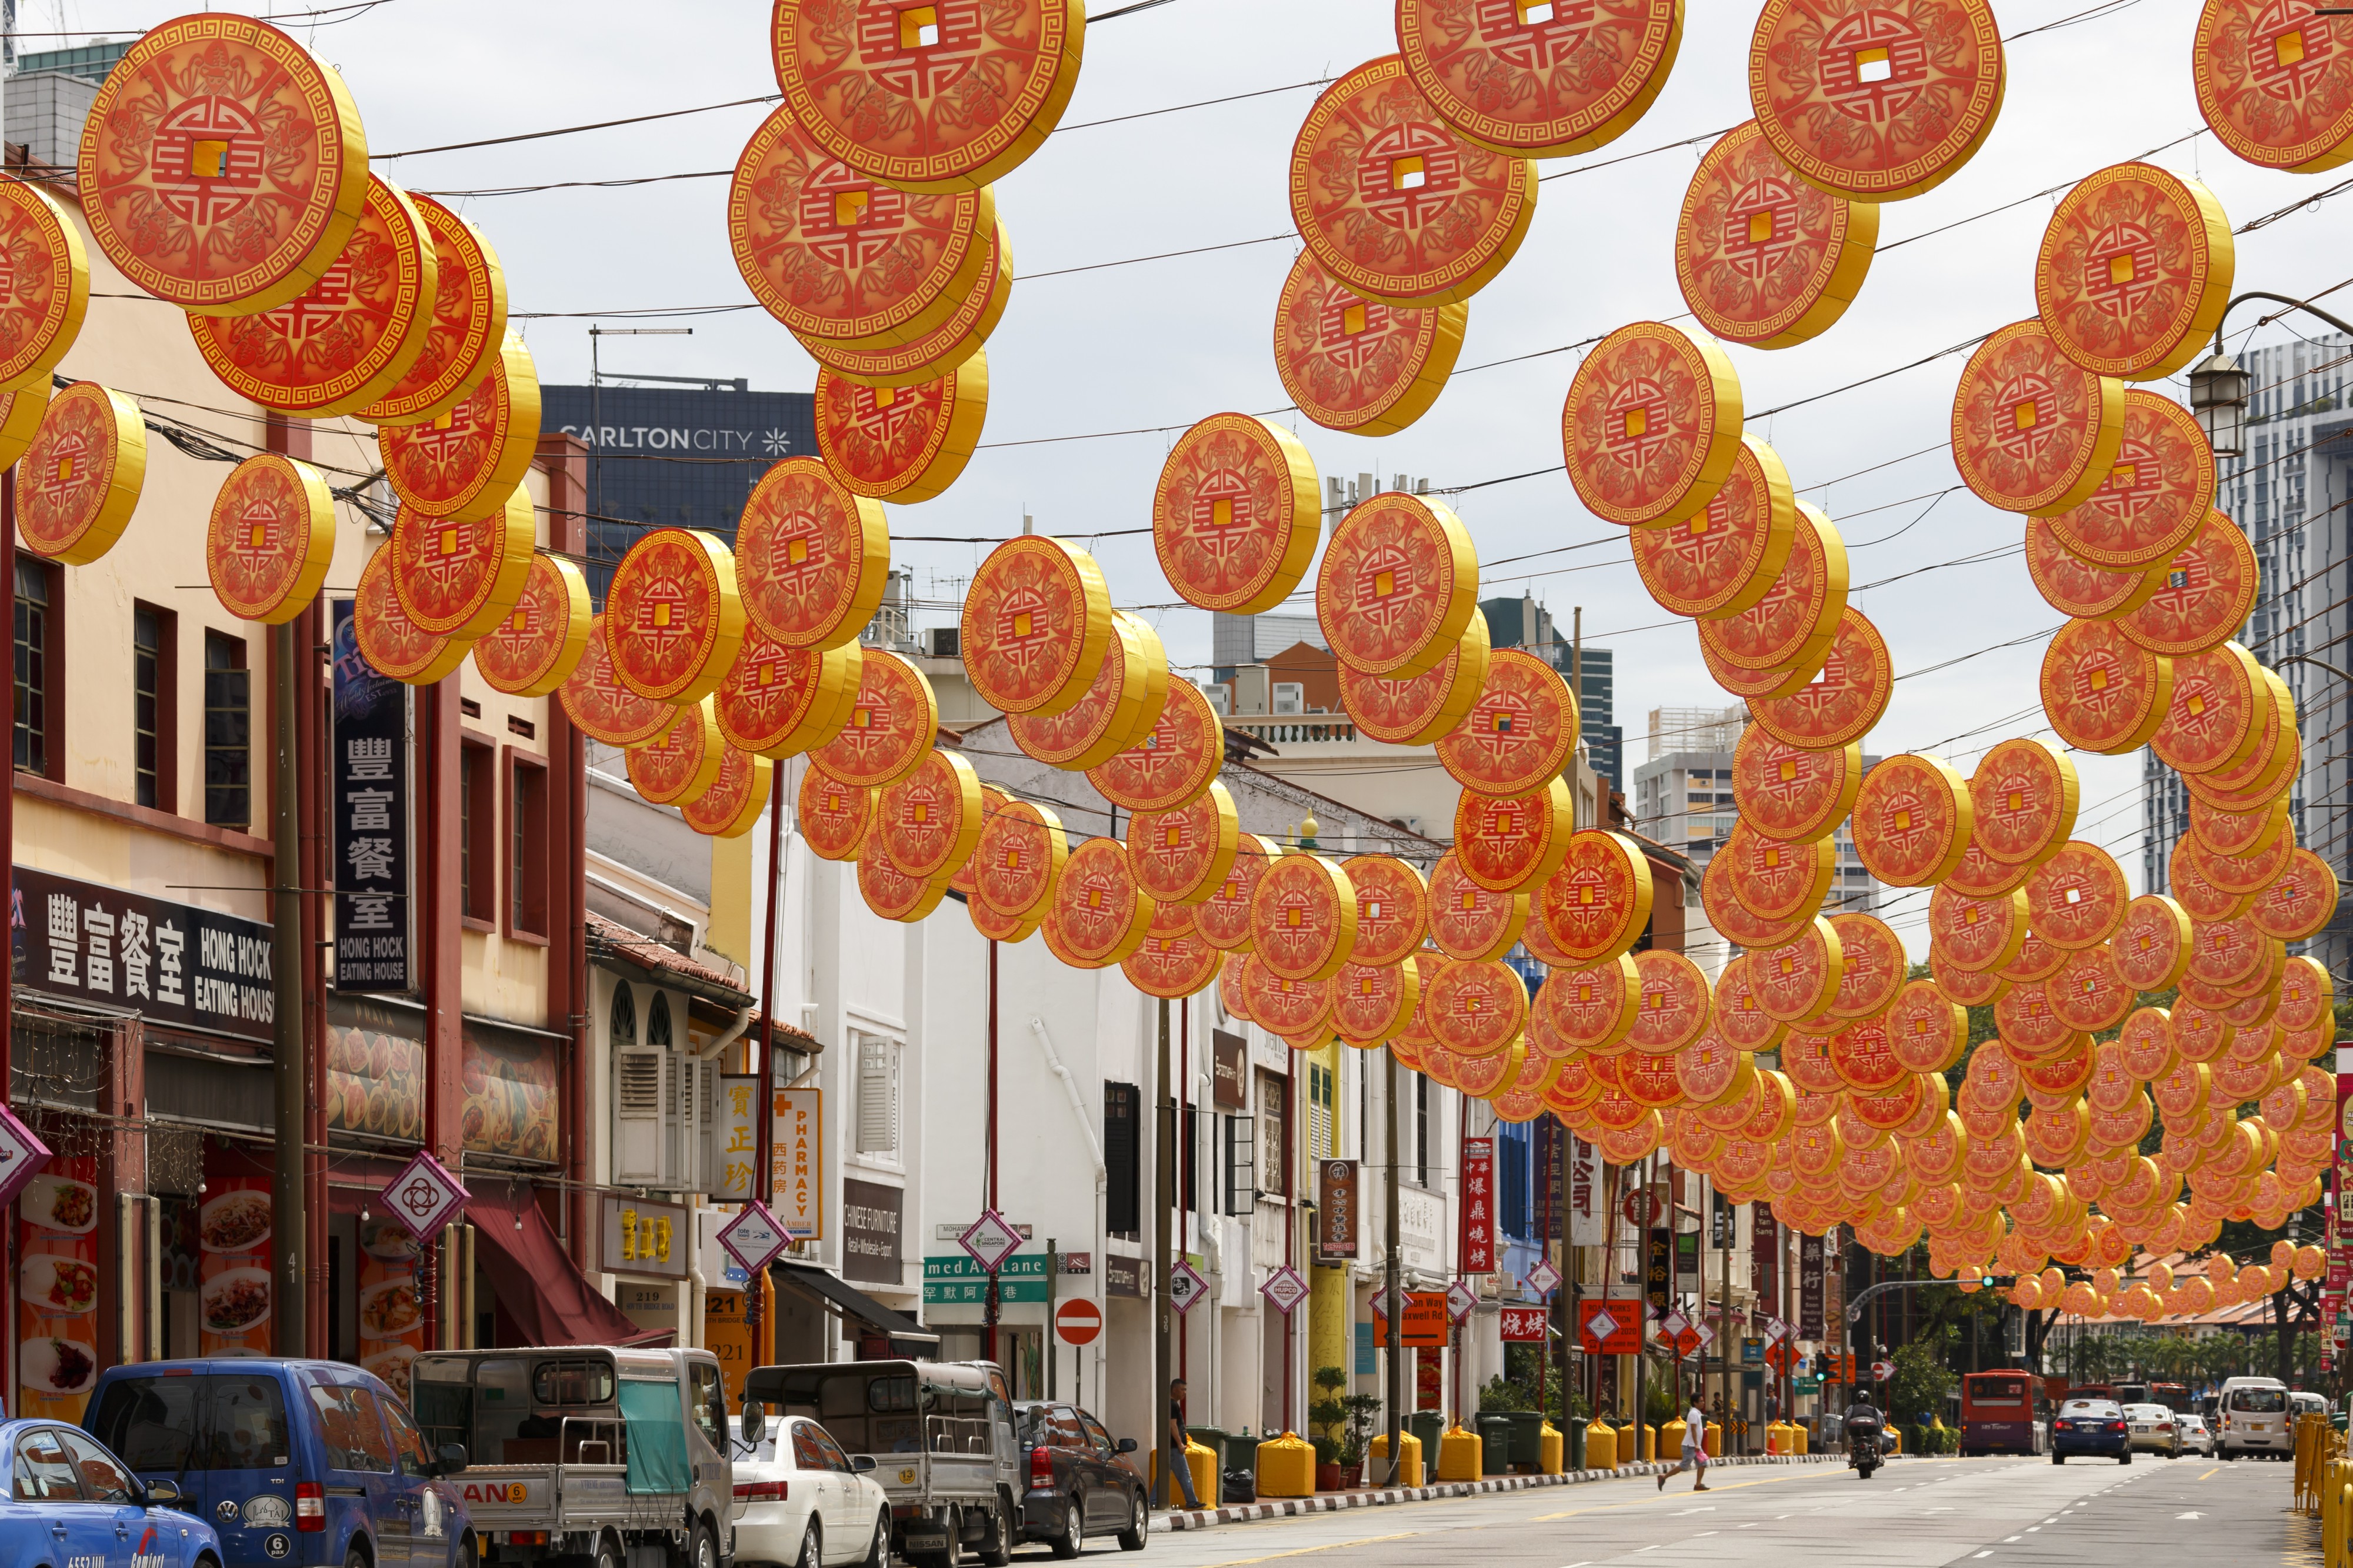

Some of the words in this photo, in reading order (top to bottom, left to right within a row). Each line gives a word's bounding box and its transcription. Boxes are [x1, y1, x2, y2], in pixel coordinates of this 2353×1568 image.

[347, 738, 395, 929] 豐富餐室
[48, 893, 185, 1006] 豐富餐室
[201, 928, 235, 972] HONG
[238, 936, 272, 980] HOCK
[340, 938, 370, 958] HONG
[373, 937, 404, 958] HOCK
[340, 963, 372, 980] EATING
[374, 963, 404, 980] HOUSE
[195, 976, 238, 1017] EATING
[241, 985, 274, 1024] HOUS
[724, 1085, 756, 1192] 寶正珍
[772, 1143, 787, 1194] 西药房
[795, 1110, 808, 1216] PHARMACY
[1465, 1161, 1490, 1175] 中華
[844, 1203, 866, 1229] CHINESE
[868, 1207, 896, 1234] FURNITURE
[1755, 1228, 1773, 1236] Sang
[848, 1236, 858, 1253] Retail
[861, 1238, 878, 1256] Wholesale
[881, 1241, 892, 1260] Export
[1001, 1262, 1042, 1273] Lane
[636, 1292, 659, 1302] 219
[924, 1285, 1017, 1300] 罕默阿巷
[1426, 1298, 1443, 1309] Way
[1588, 1304, 1602, 1312] ROA
[1402, 1311, 1429, 1320] axwell
[1432, 1310, 1443, 1320] Rd
[1661, 1335, 1696, 1344] CATION
[900, 1469, 913, 1479] 13
[513, 1486, 520, 1497] 6
[268, 1510, 284, 1519] TAJ
[272, 1537, 282, 1549] 6
